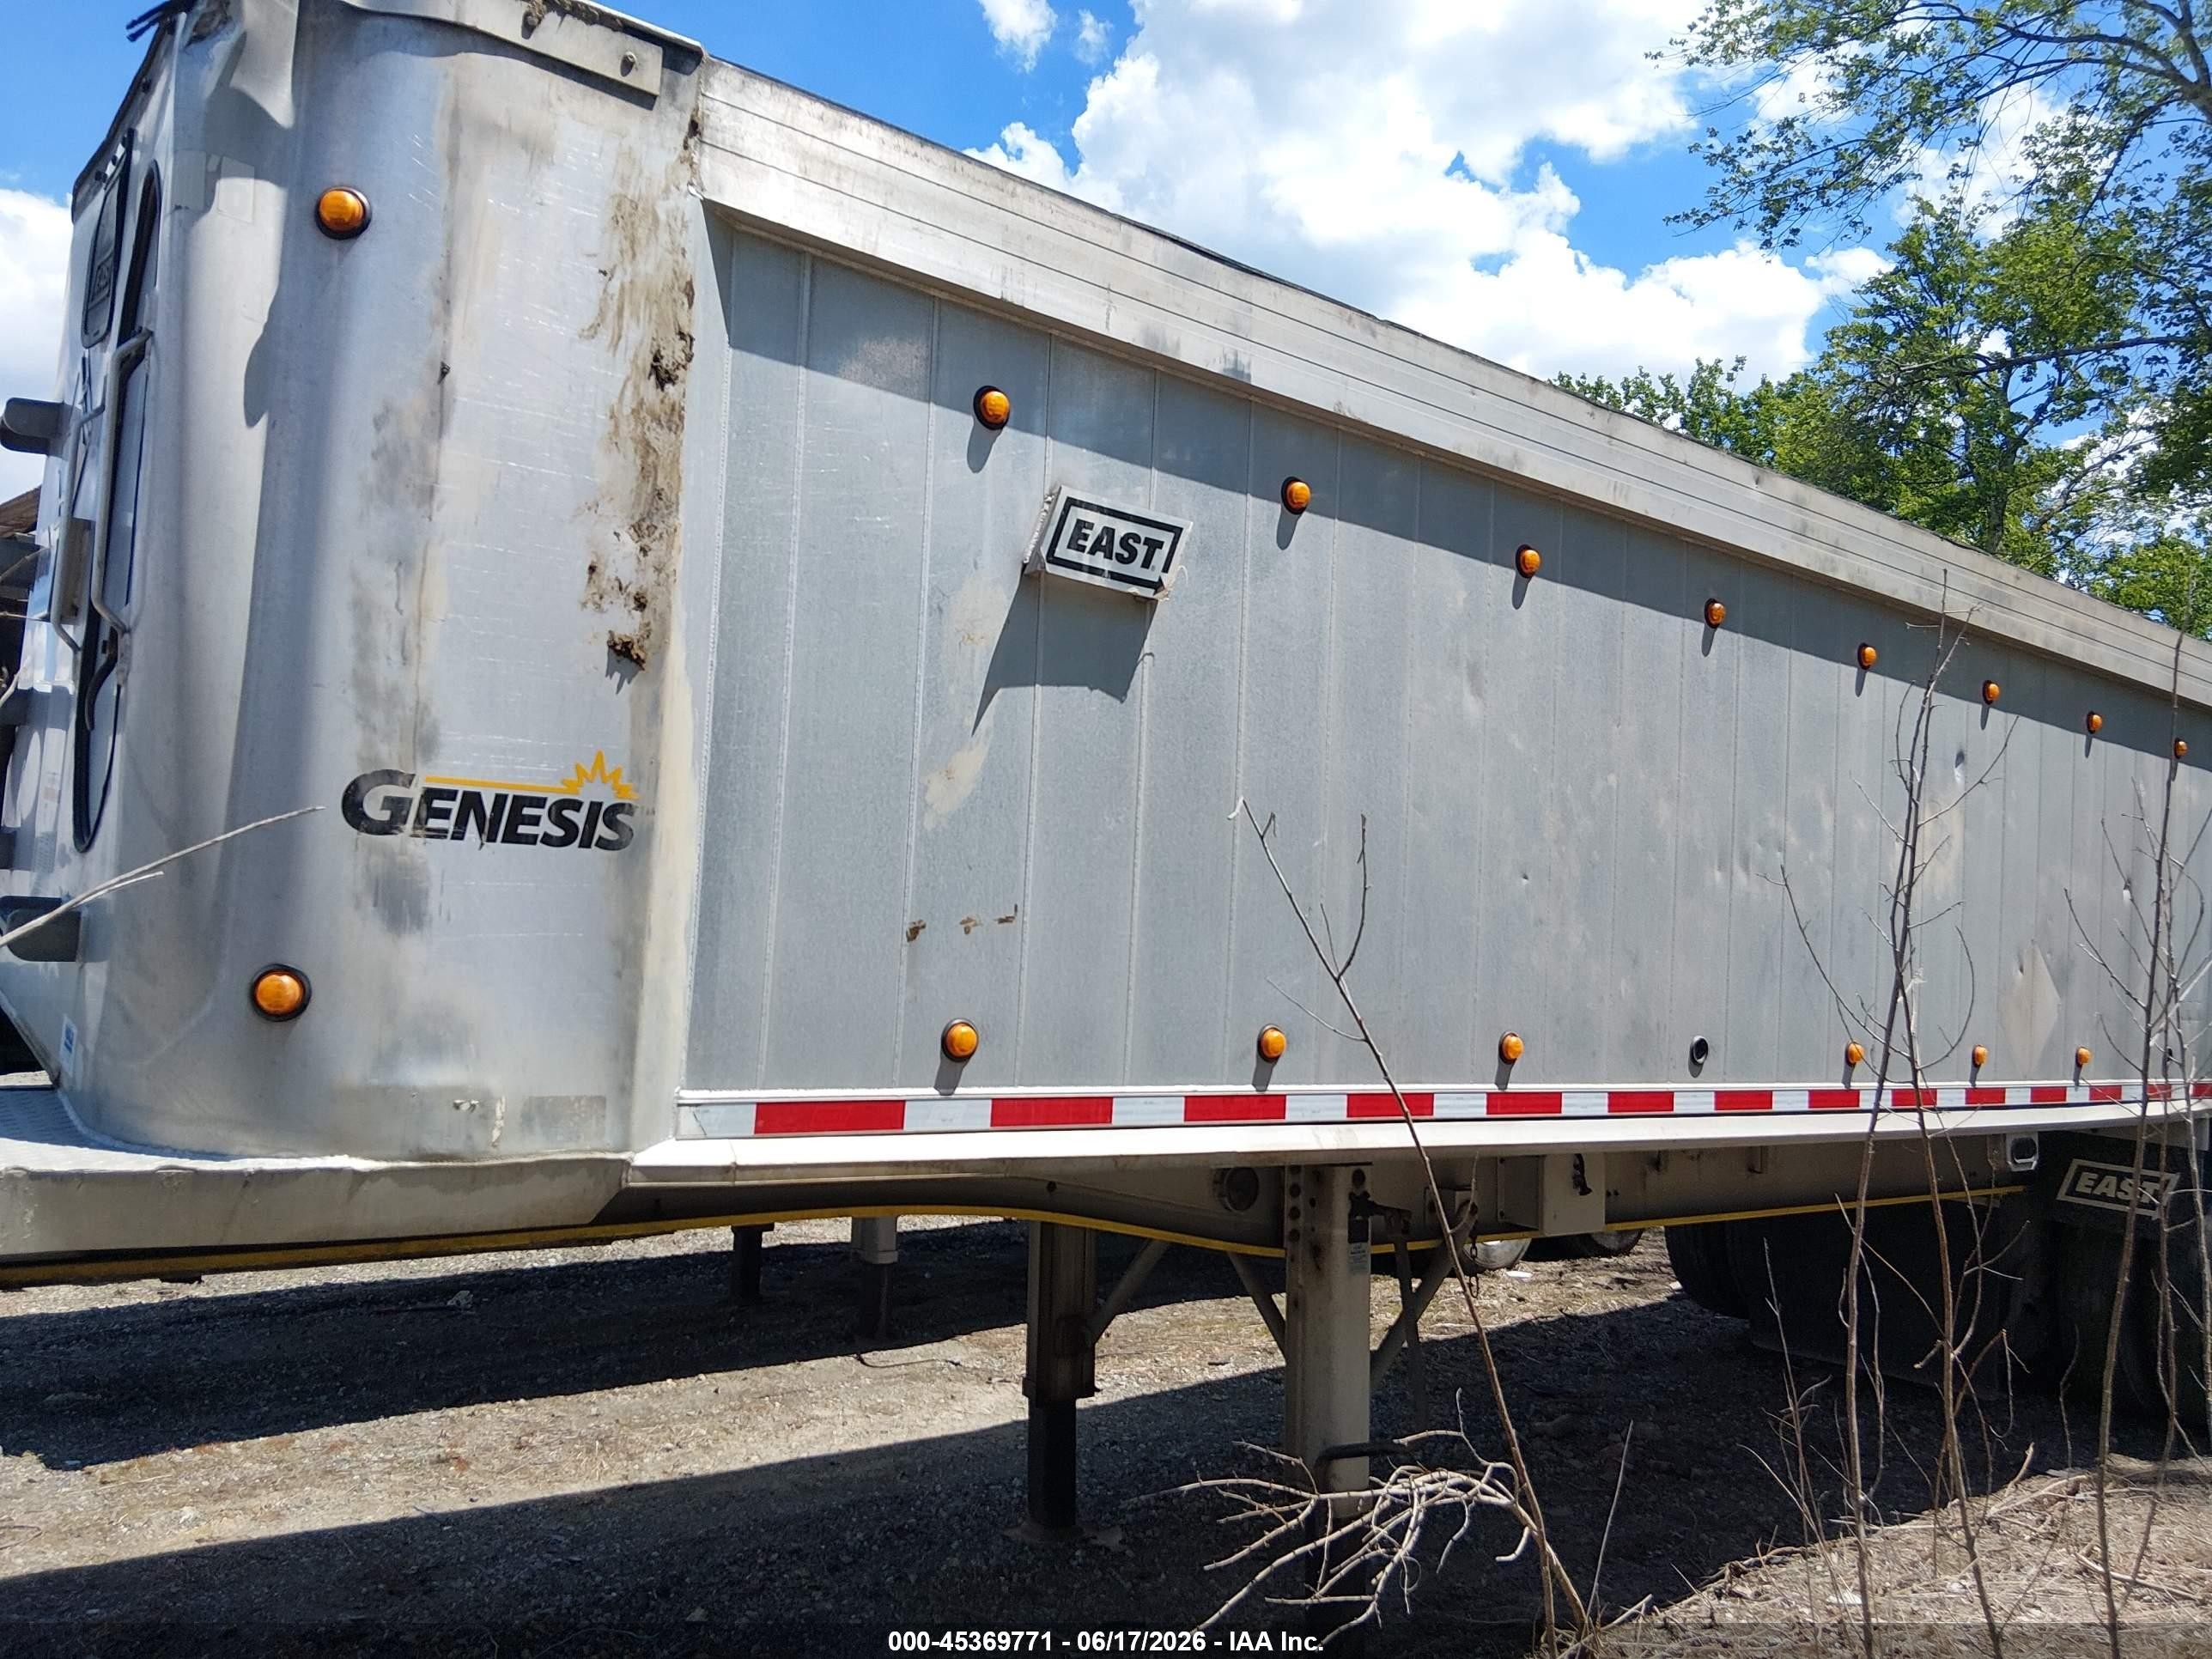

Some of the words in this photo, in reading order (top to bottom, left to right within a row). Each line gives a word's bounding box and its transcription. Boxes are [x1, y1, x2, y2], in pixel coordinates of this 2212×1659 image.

[1066, 518, 1164, 570] EAST
[341, 769, 638, 851] GENESIS
[2075, 1171, 2160, 1204] EAST
